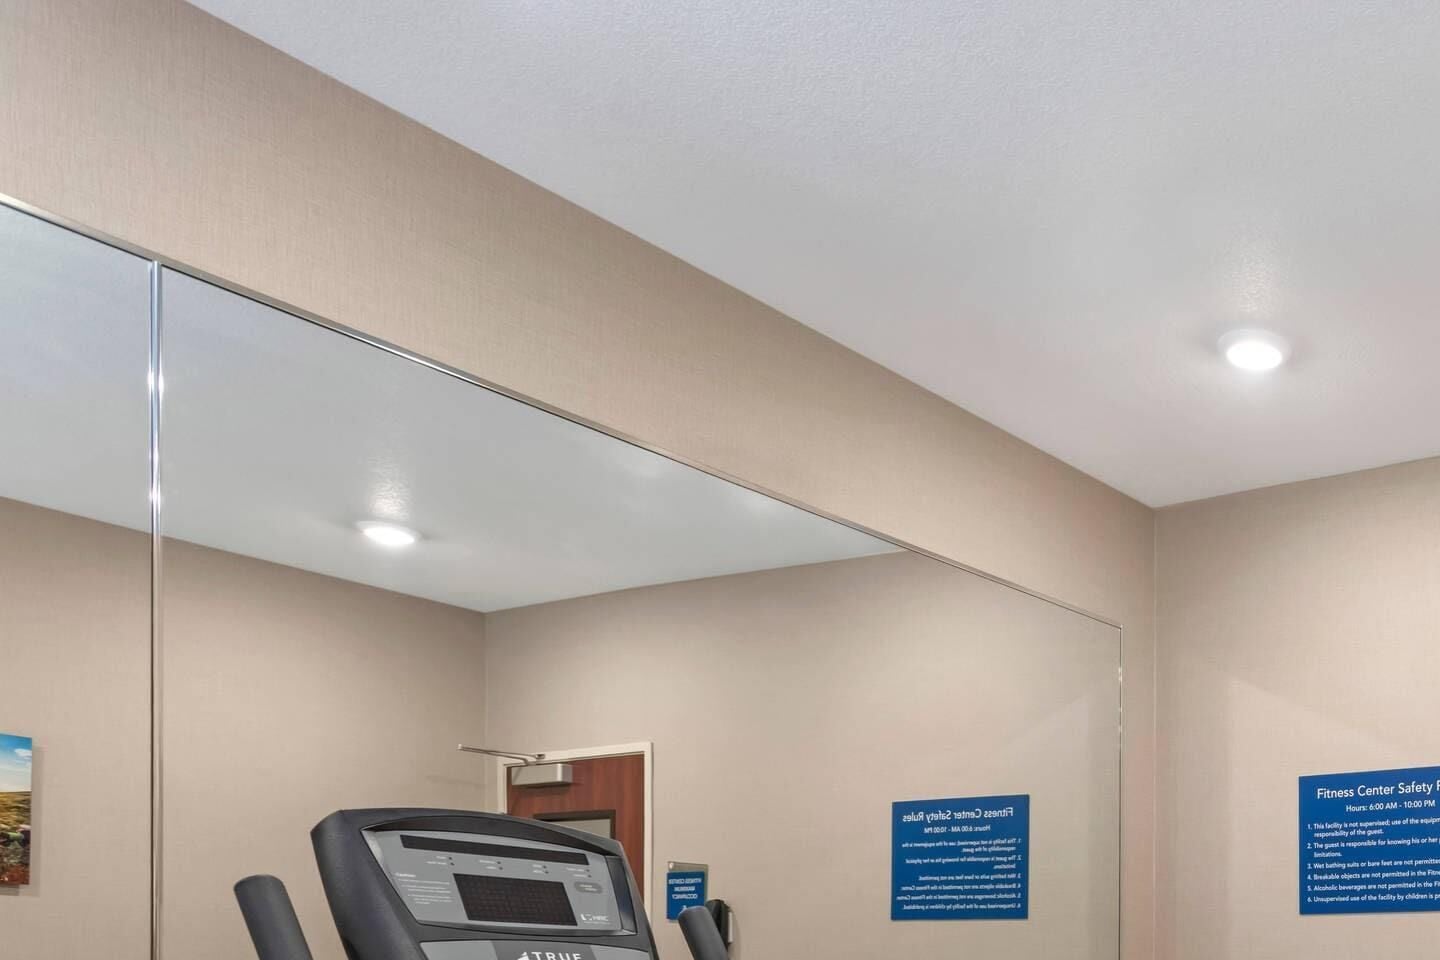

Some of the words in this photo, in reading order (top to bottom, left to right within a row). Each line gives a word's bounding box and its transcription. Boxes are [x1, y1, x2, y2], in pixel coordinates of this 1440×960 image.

[1317, 788, 1354, 799] Fitness
[1357, 785, 1394, 796] Center
[1398, 781, 1433, 795] Safety
[1404, 800, 1422, 808] 10:00
[1325, 822, 1343, 830] facility
[1346, 840, 1377, 848] responsible
[1382, 870, 1410, 879] permitted
[1388, 881, 1416, 890] permitted
[1313, 895, 1349, 903] Unsupervised
